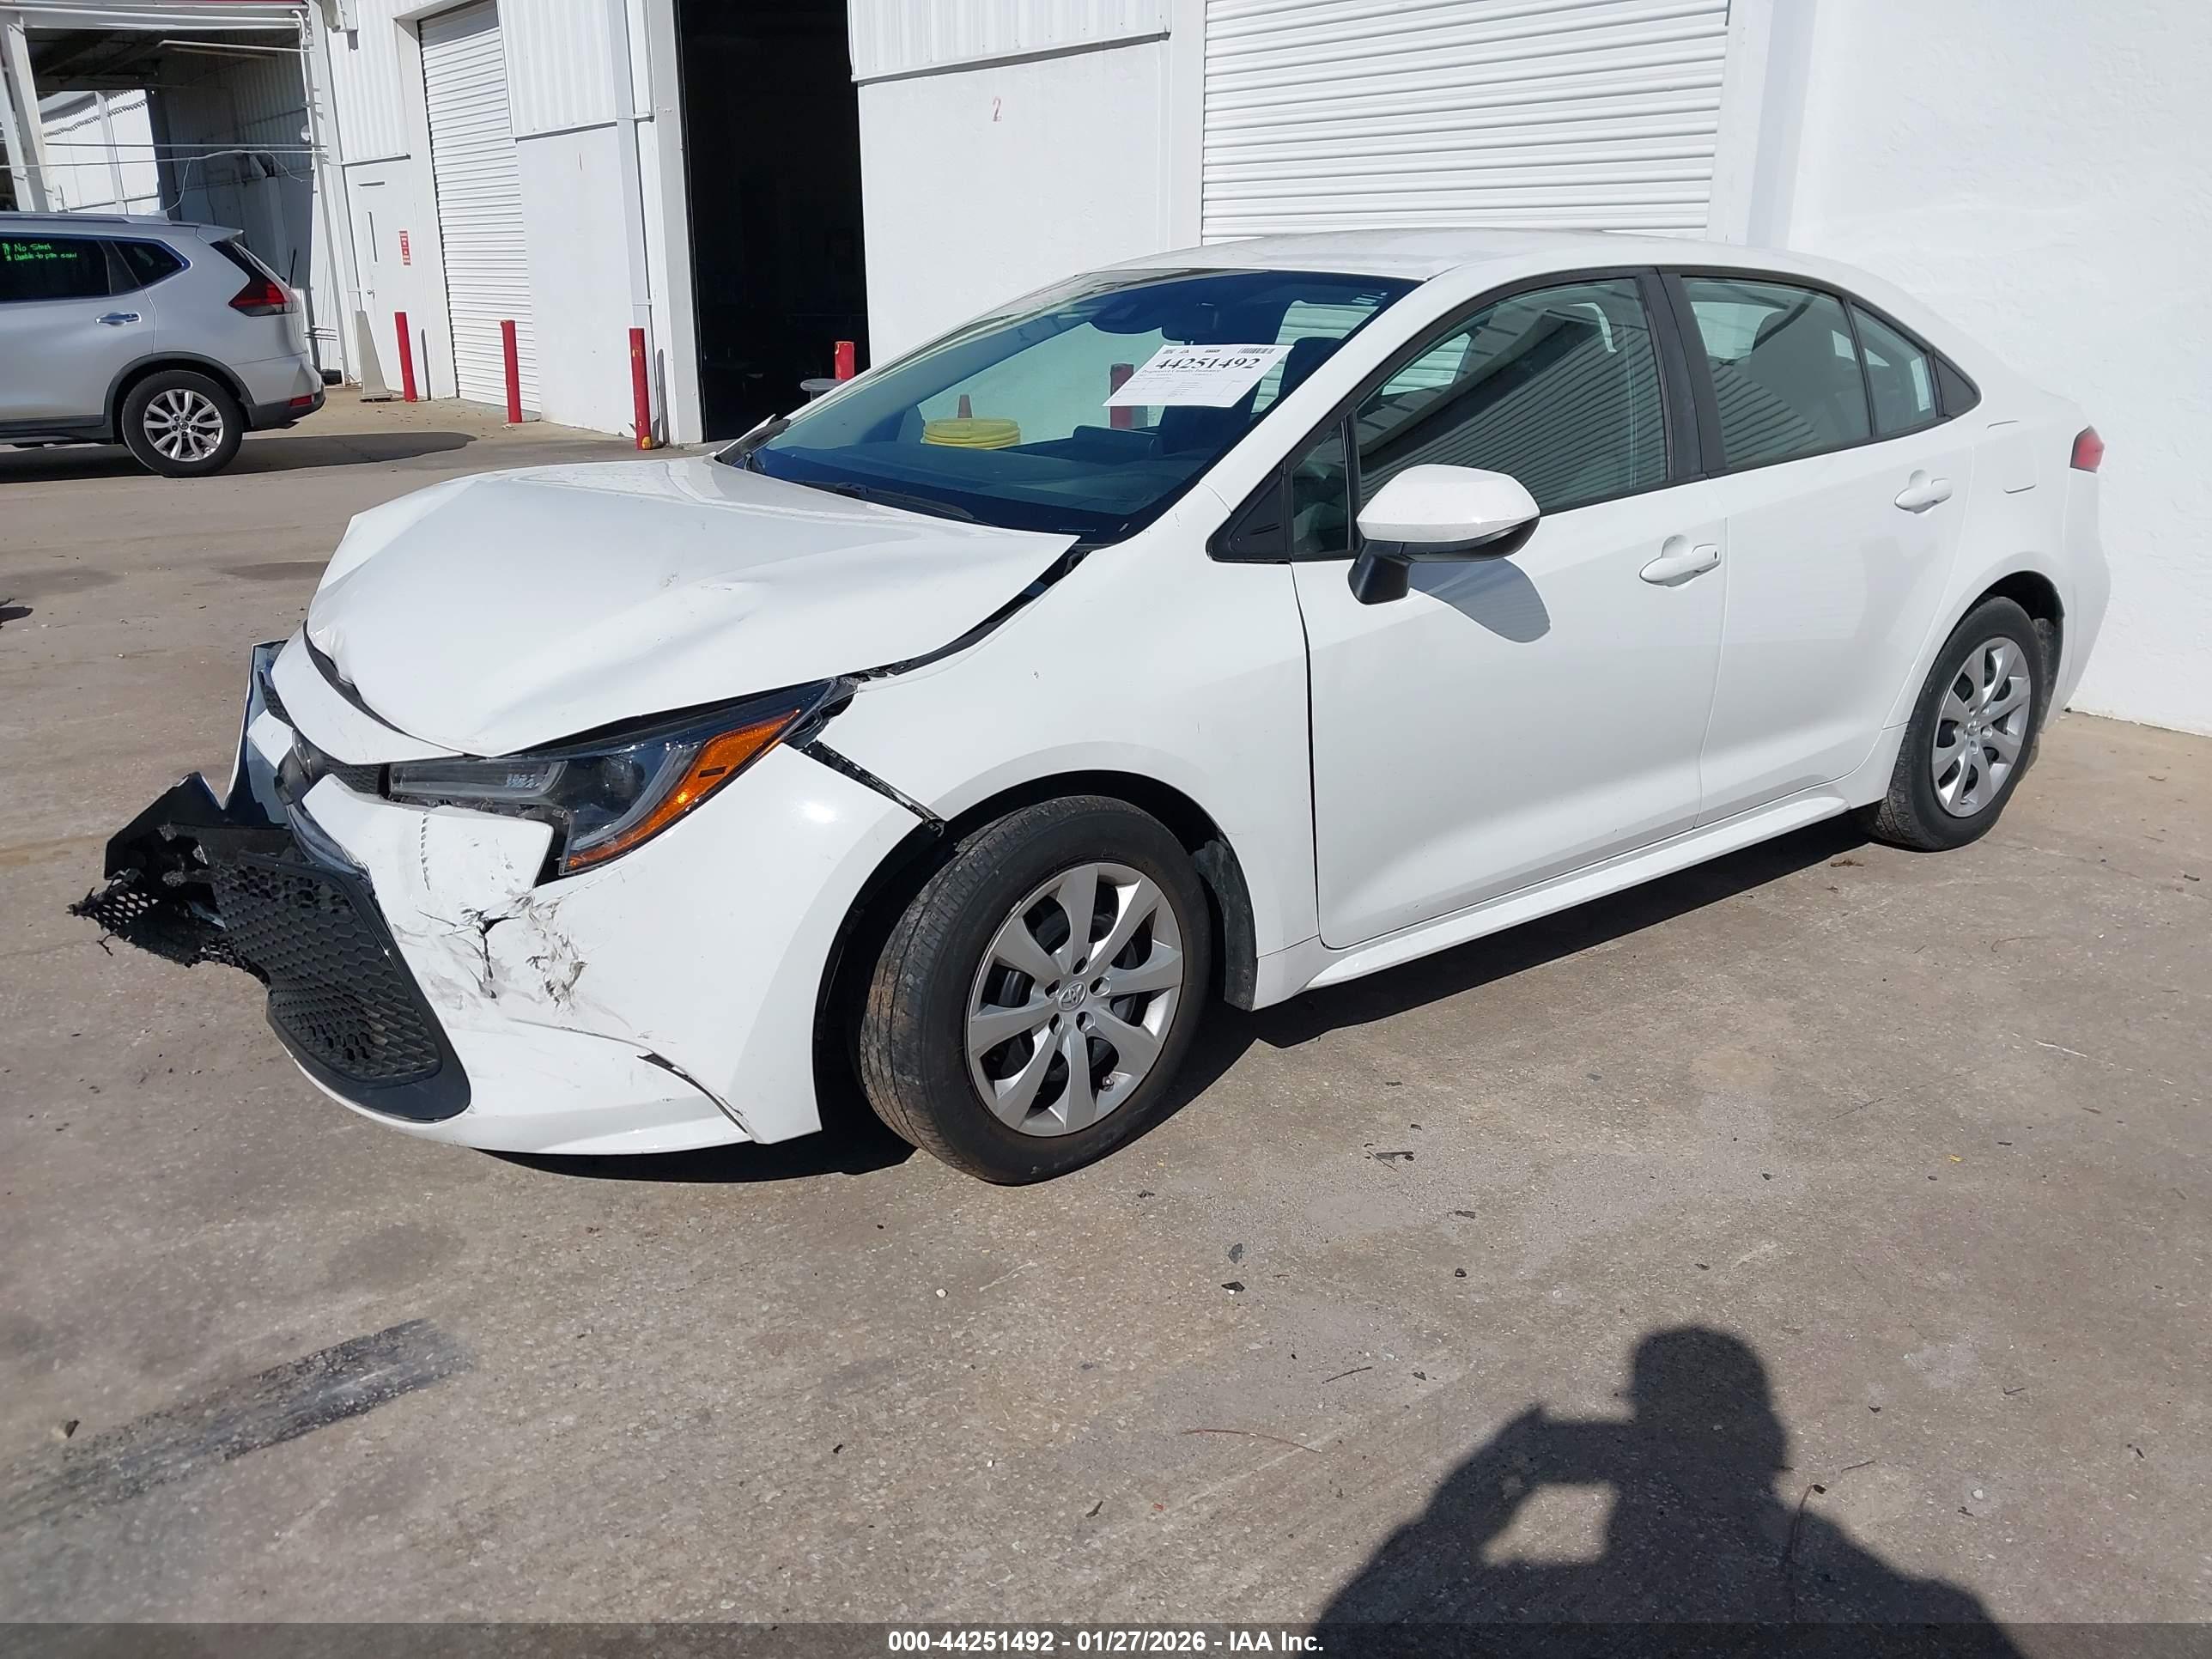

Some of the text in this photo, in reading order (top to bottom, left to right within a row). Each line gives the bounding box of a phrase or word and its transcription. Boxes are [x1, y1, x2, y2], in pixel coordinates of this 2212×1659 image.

[992, 96, 1003, 122] 2
[14, 243, 27, 252] No
[1155, 357, 1261, 369] 44251492
